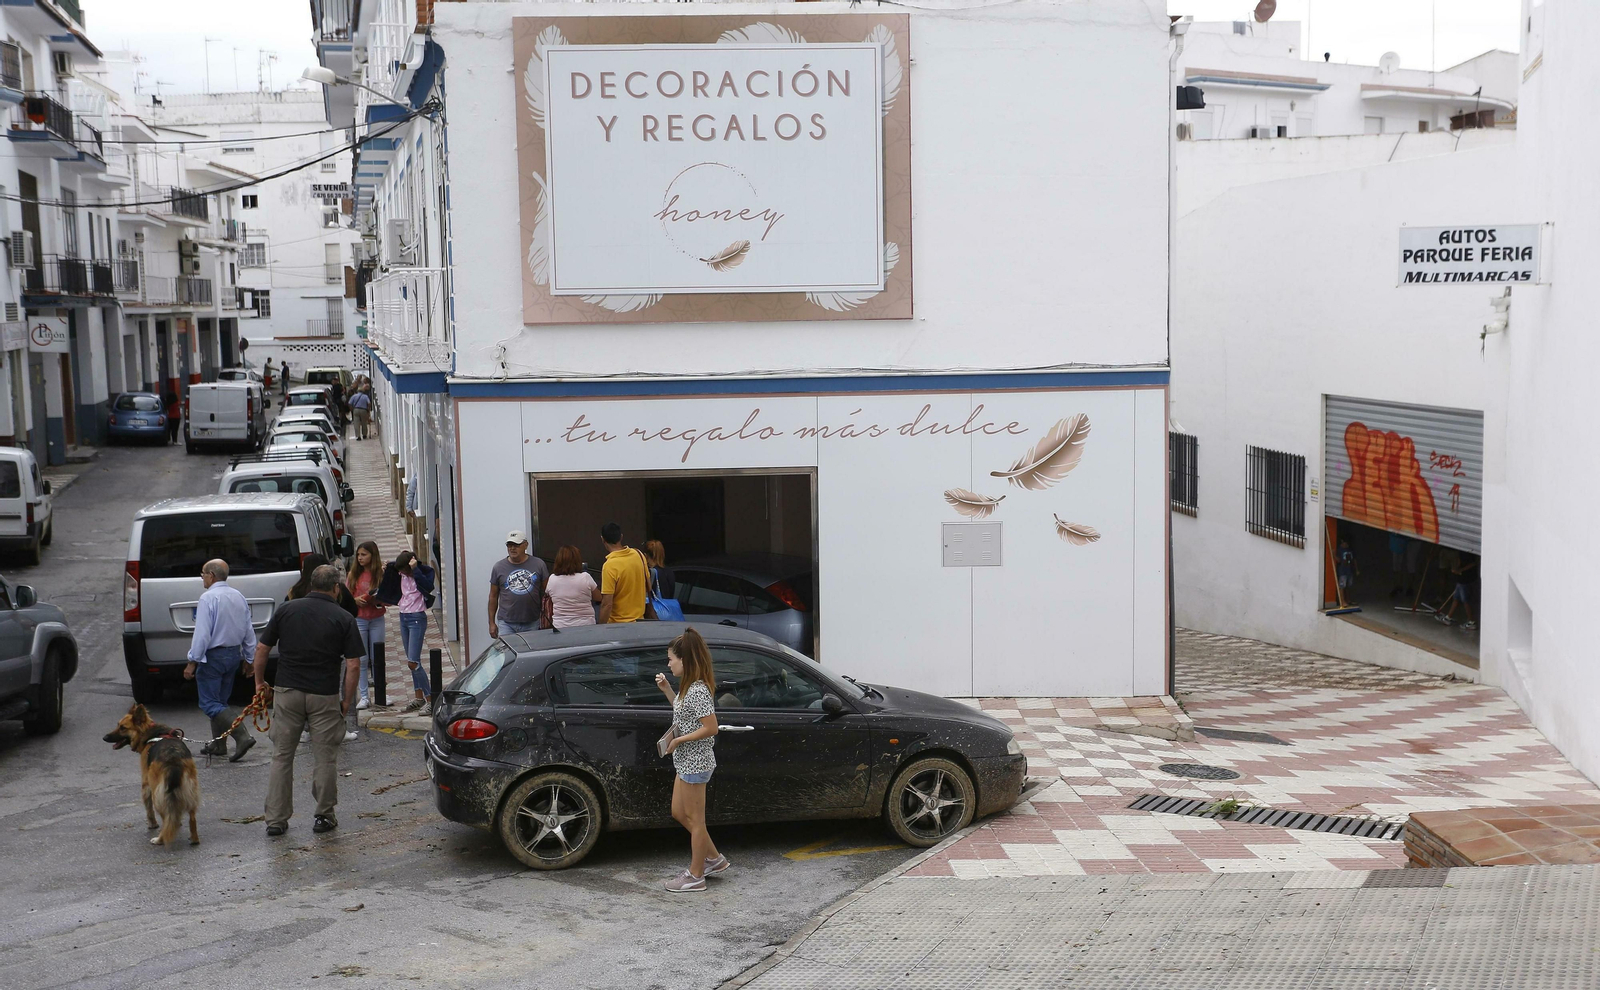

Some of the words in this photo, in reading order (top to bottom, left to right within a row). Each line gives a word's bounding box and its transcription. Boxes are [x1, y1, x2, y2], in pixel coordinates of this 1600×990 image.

[570, 64, 852, 99] DECORACIÓN
[596, 115, 618, 142] Y
[642, 113, 828, 141] REGALOS
[654, 194, 785, 241] honey
[1438, 229, 1497, 245] AUTOS
[1403, 248, 1473, 264] PARQUE
[1480, 246, 1533, 262] FERIA
[1404, 271, 1532, 283] MULTIMARCAS
[628, 408, 783, 463] regalo
[793, 408, 889, 439] más
[896, 404, 1029, 437] dulce
